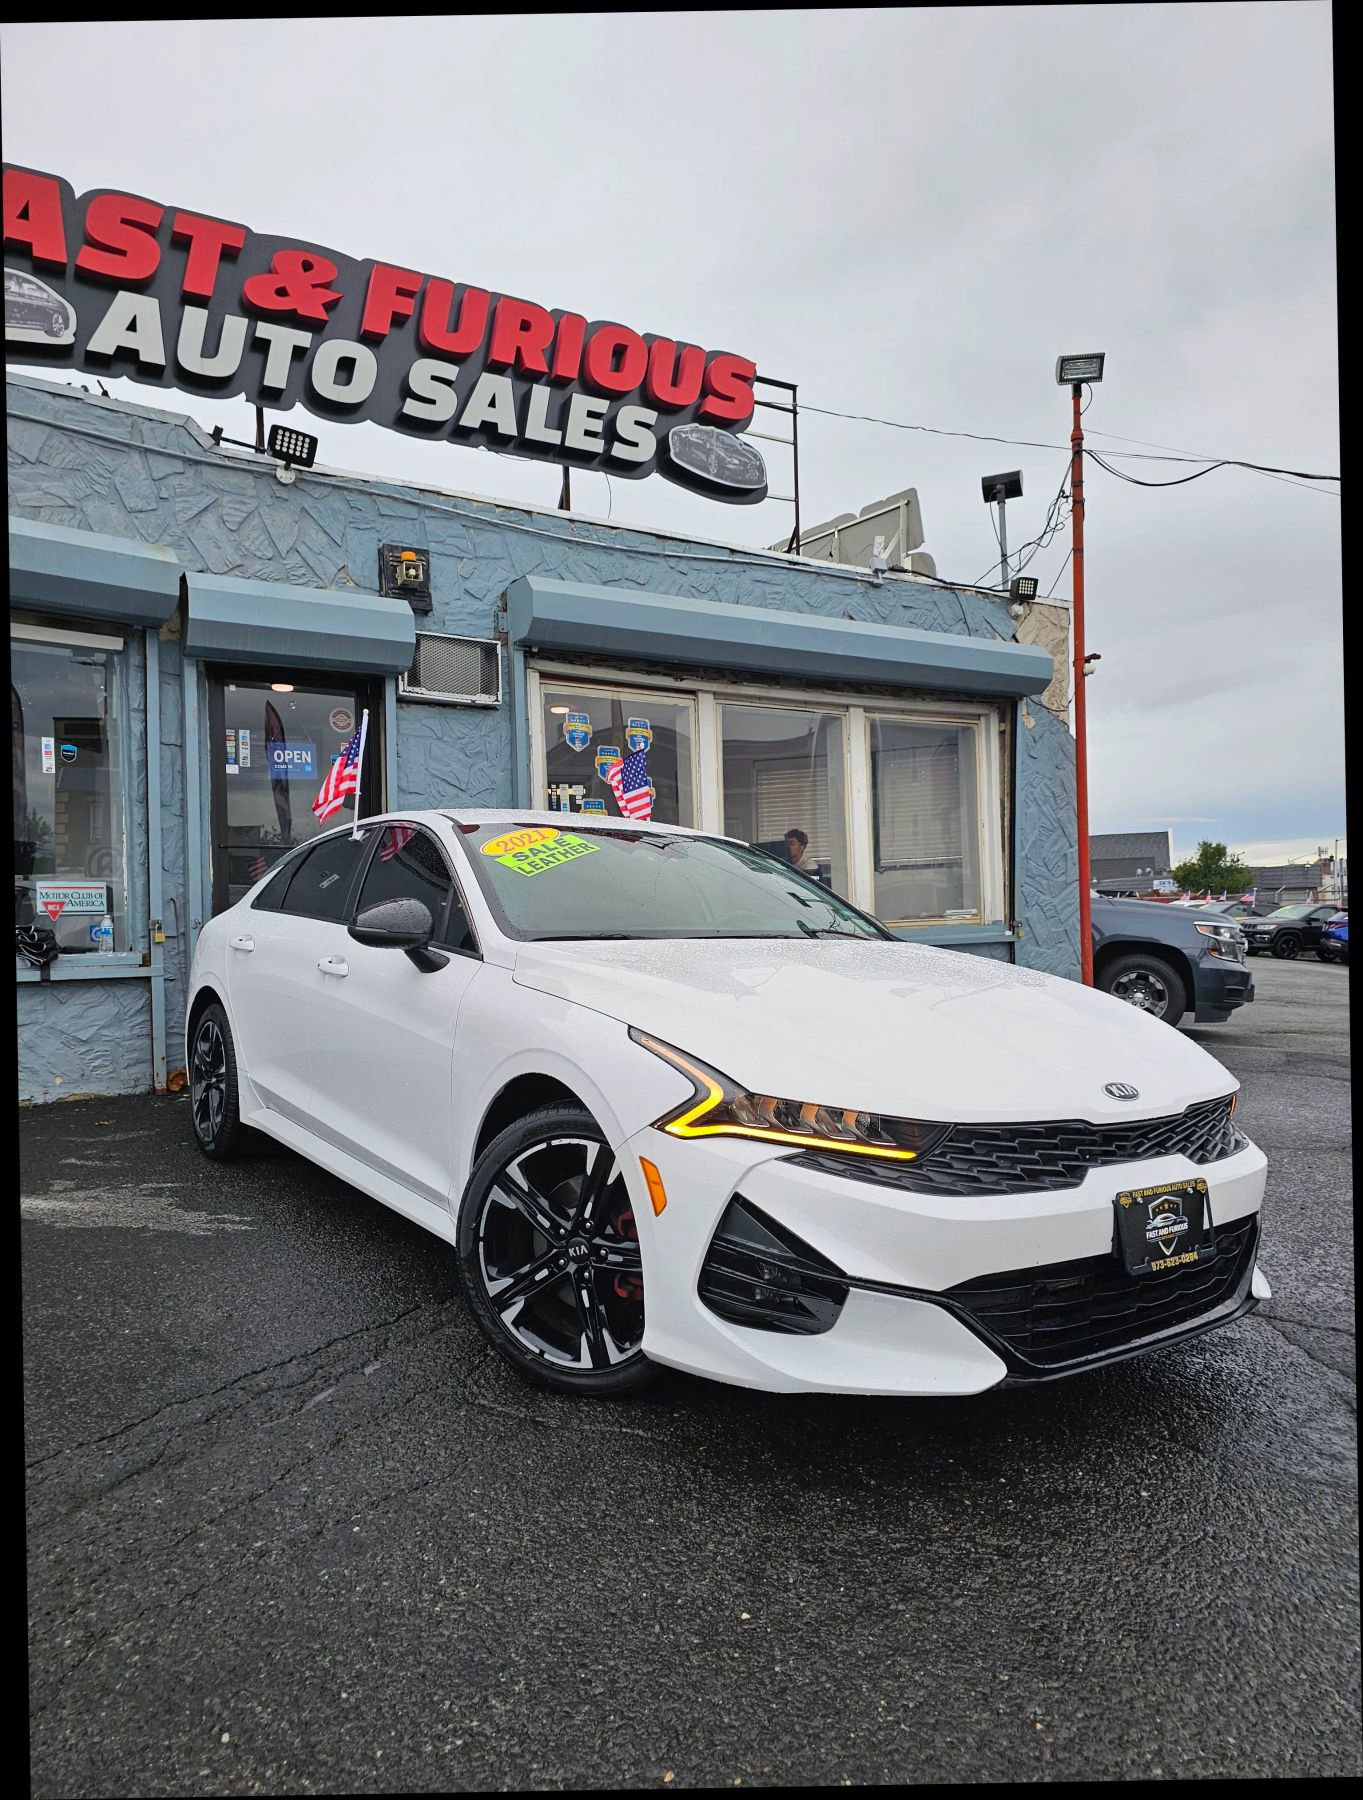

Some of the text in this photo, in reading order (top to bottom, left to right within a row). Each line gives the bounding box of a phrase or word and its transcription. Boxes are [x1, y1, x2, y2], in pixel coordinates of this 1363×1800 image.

[243, 248, 345, 323] &
[360, 263, 757, 421] FURIOUS
[86, 290, 658, 463] AUTO SALES
[273, 750, 312, 763] OPEN
[496, 830, 550, 852] 2021
[512, 838, 571, 861] SALE
[517, 842, 595, 875] LEATHER
[40, 891, 71, 900] MOTOR
[71, 891, 94, 900] CLUB
[66, 899, 105, 907] AMERICA
[1106, 1084, 1138, 1097] KIA
[1132, 1191, 1144, 1199] FAST
[1153, 1185, 1171, 1194] FURIOUS
[1171, 1183, 1182, 1191] AUTO
[1182, 1181, 1195, 1189] SALES
[1146, 1230, 1159, 1239] FAST
[1159, 1227, 1169, 1236] AND
[1168, 1222, 1188, 1233] FURIOUS
[568, 1245, 588, 1257] KIA
